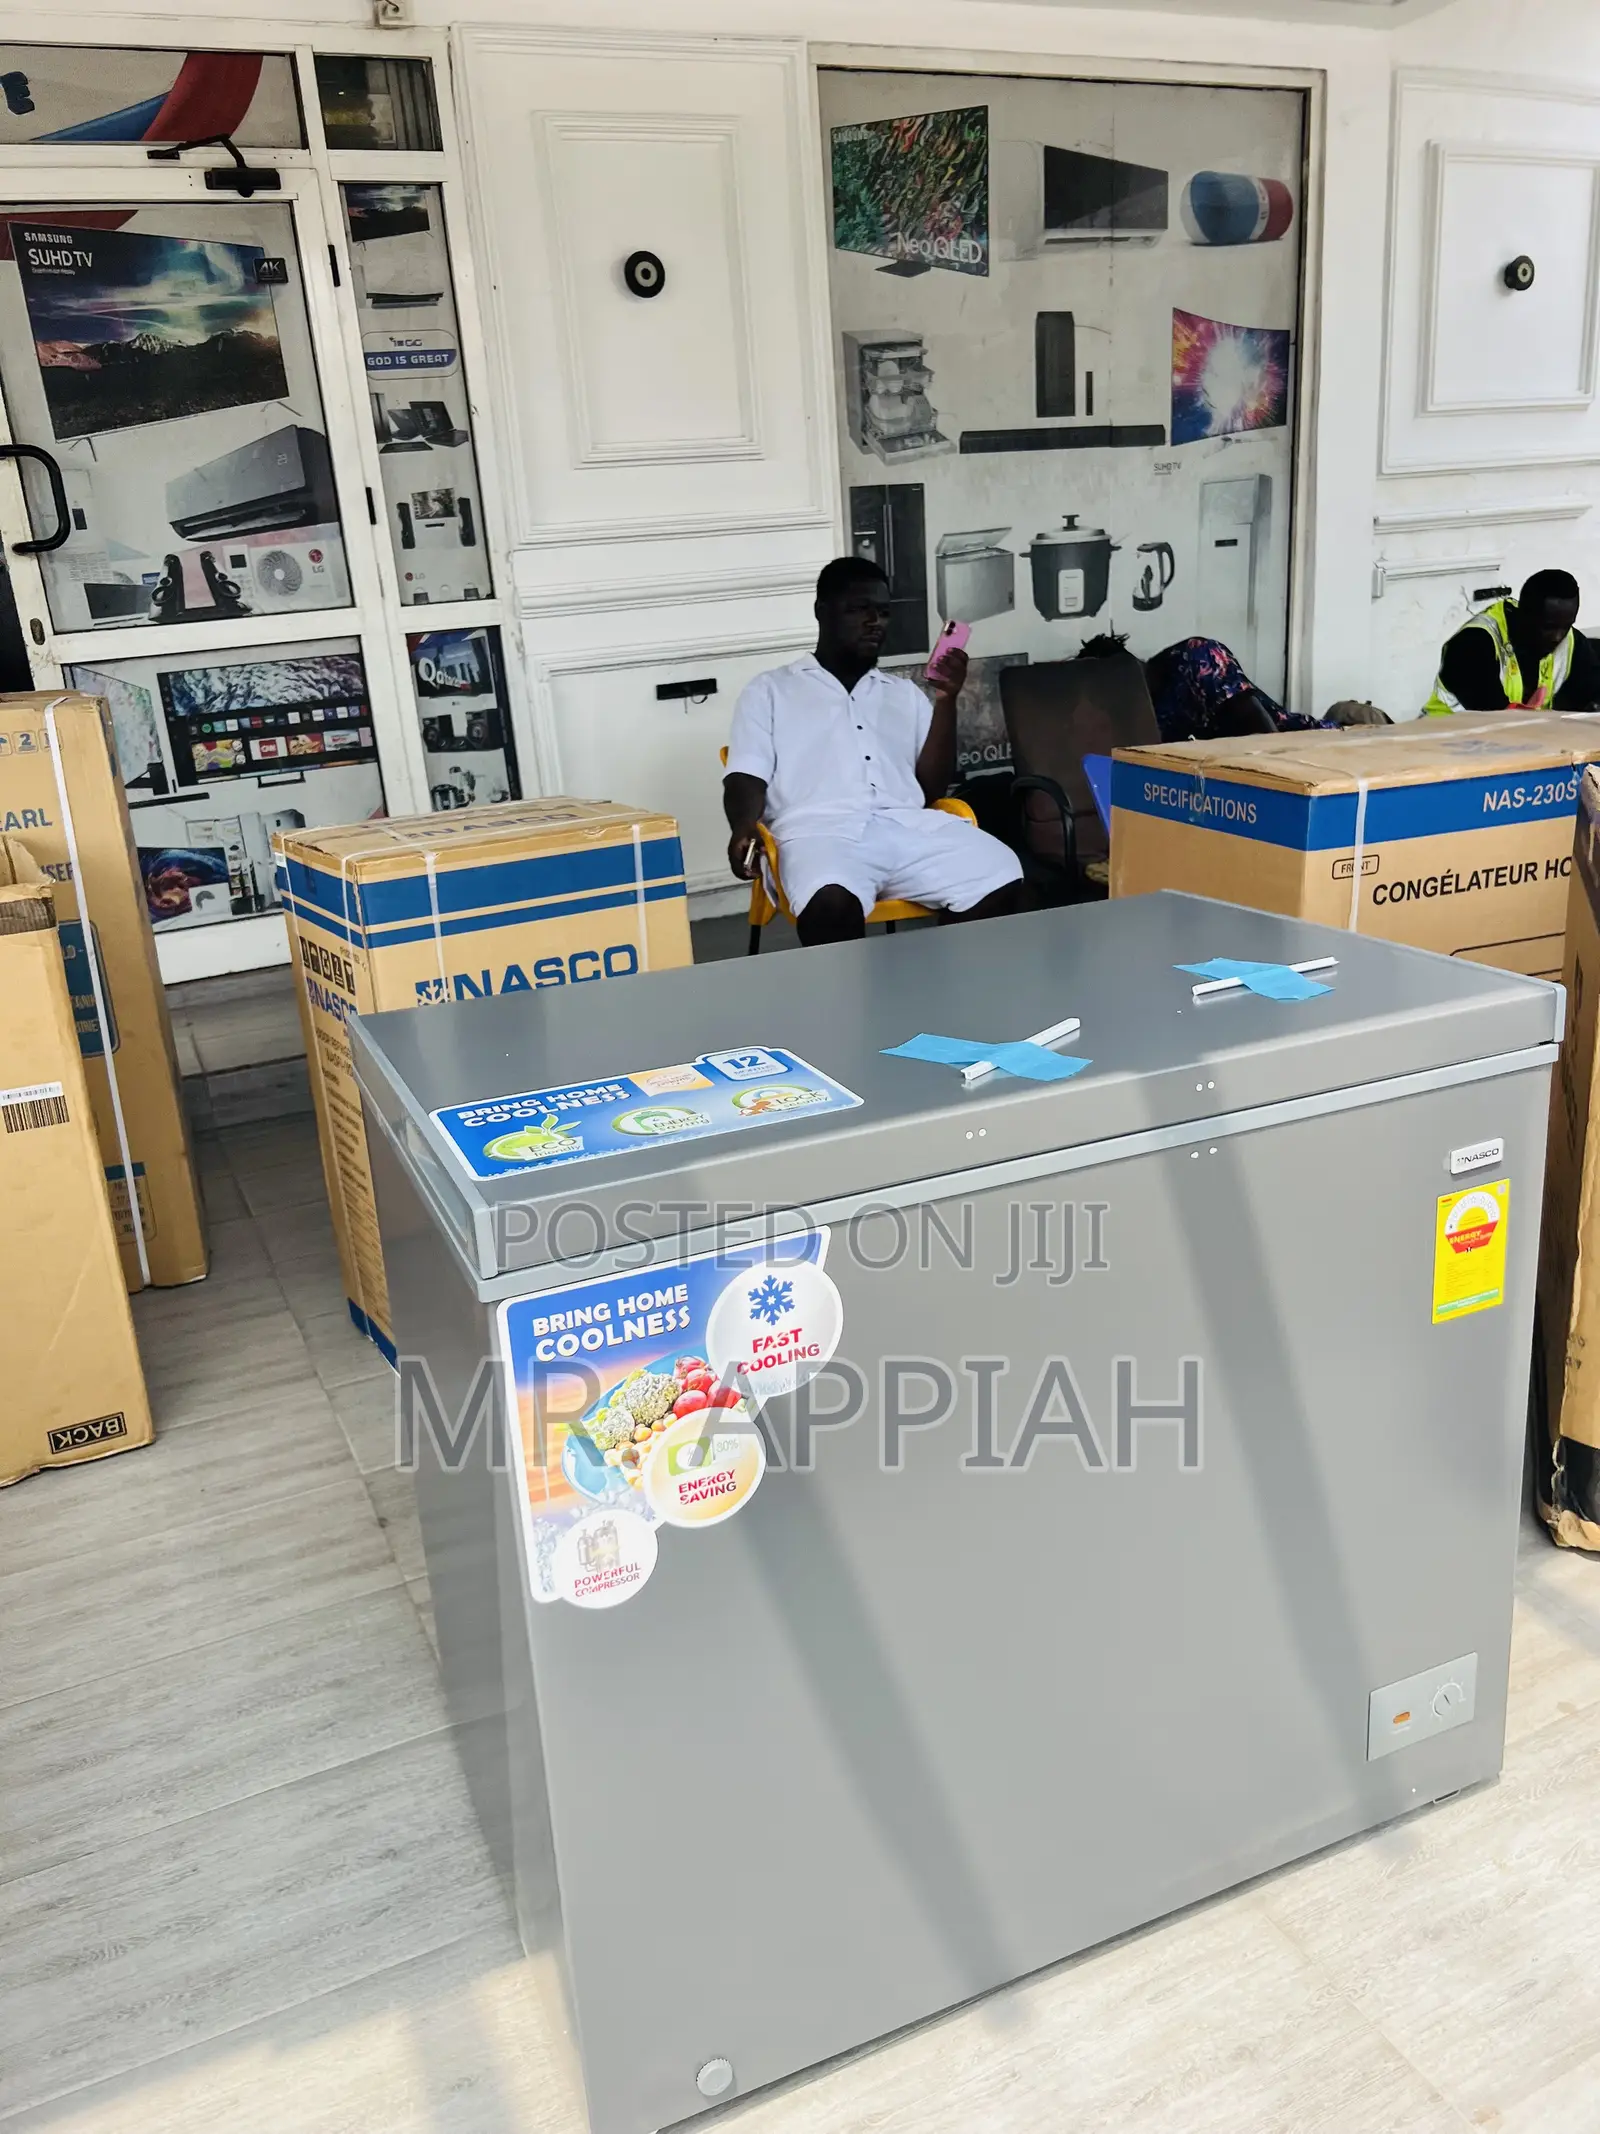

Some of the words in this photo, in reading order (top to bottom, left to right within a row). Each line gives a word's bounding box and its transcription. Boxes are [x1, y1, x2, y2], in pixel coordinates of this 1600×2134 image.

[24, 232, 73, 244] SAMSUNG
[934, 236, 982, 264] QLED
[367, 357, 392, 366] GOD
[395, 355, 407, 365] IS
[410, 354, 449, 364] GREAT
[312, 565, 325, 574] LG
[959, 751, 981, 766] eo
[983, 742, 1012, 762] QLE
[1143, 782, 1258, 825] SPECIFICATIONS
[1483, 780, 1578, 813] NAS-230S
[0, 807, 53, 832] ARL
[1341, 860, 1371, 874] FRNT
[1372, 859, 1539, 906] CONGÉLATEUR
[453, 943, 639, 1002] NASCO
[722, 1055, 767, 1070] 12
[457, 1098, 543, 1120] BRING
[546, 1083, 624, 1103] HOME
[463, 1090, 632, 1128] COOLNESS
[776, 1090, 824, 1105] LOCK
[528, 1137, 577, 1153] ECO
[1464, 1147, 1500, 1164] NASCO
[532, 1302, 612, 1337] BRING
[617, 1283, 689, 1317] HOME
[535, 1305, 691, 1362] COOLNESS
[752, 1327, 803, 1354] FAST
[737, 1343, 820, 1375] COOLING
[56, 1418, 121, 1449] BACK
[678, 1469, 736, 1494] ENERGY
[679, 1481, 737, 1505] SAVING
[574, 1562, 641, 1589] POWERFUL
[575, 1572, 641, 1598] COMPRESSOR
